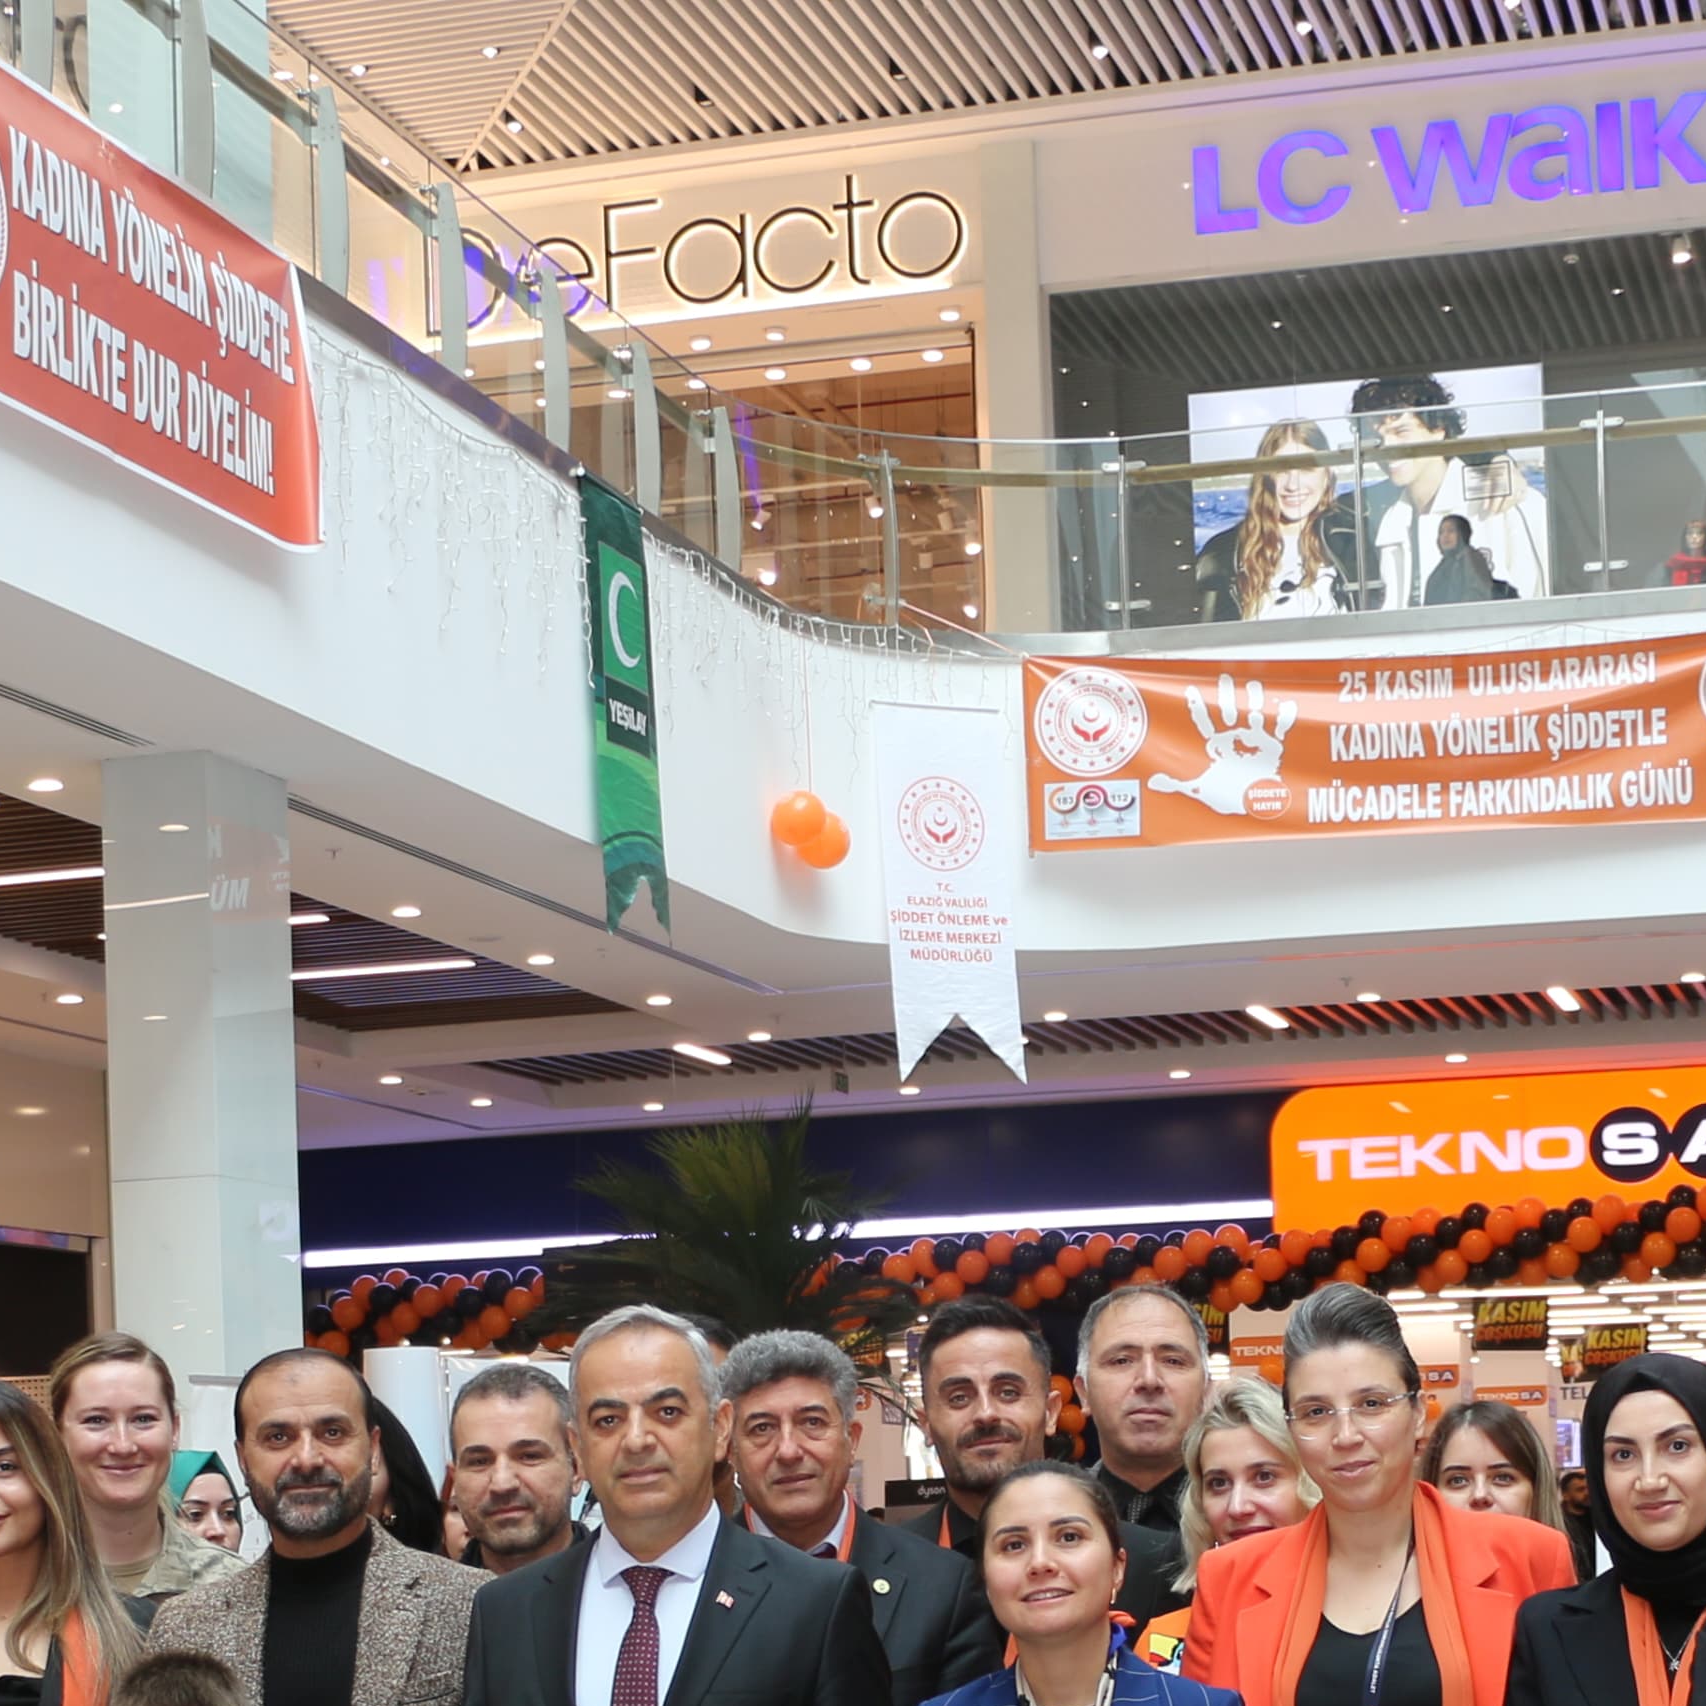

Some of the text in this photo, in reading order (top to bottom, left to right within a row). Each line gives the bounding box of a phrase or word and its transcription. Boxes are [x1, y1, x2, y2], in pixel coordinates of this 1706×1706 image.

[1192, 129, 1353, 236] LC
[8, 125, 108, 264] KADINA
[110, 186, 212, 328] YÖNELİK
[210, 250, 295, 385] ŞİDDETE
[426, 173, 967, 338] DeFacto
[12, 258, 276, 497] BİRLİKTE DUR DİYELİM!
[1338, 651, 1657, 703] 25 KASIM ULUSLARARASI
[1329, 703, 1668, 762] KADINA YÖNELİK ŞİDDETLE
[1307, 758, 1694, 824] MÜCADELE FARKINDALIK GÜNÜ
[890, 908, 1009, 926] ŞİDDET ÖNLEME ve
[906, 895, 988, 909] ELAZIĞ VALİLİĞİ
[899, 927, 1002, 945] İZLEME MERKEZİ
[910, 946, 993, 963] MÜDÜRLÜĞÜ
[1476, 1300, 1548, 1326] KASIM
[1586, 1326, 1649, 1349] KASIM
[917, 1484, 946, 1498] dyson
